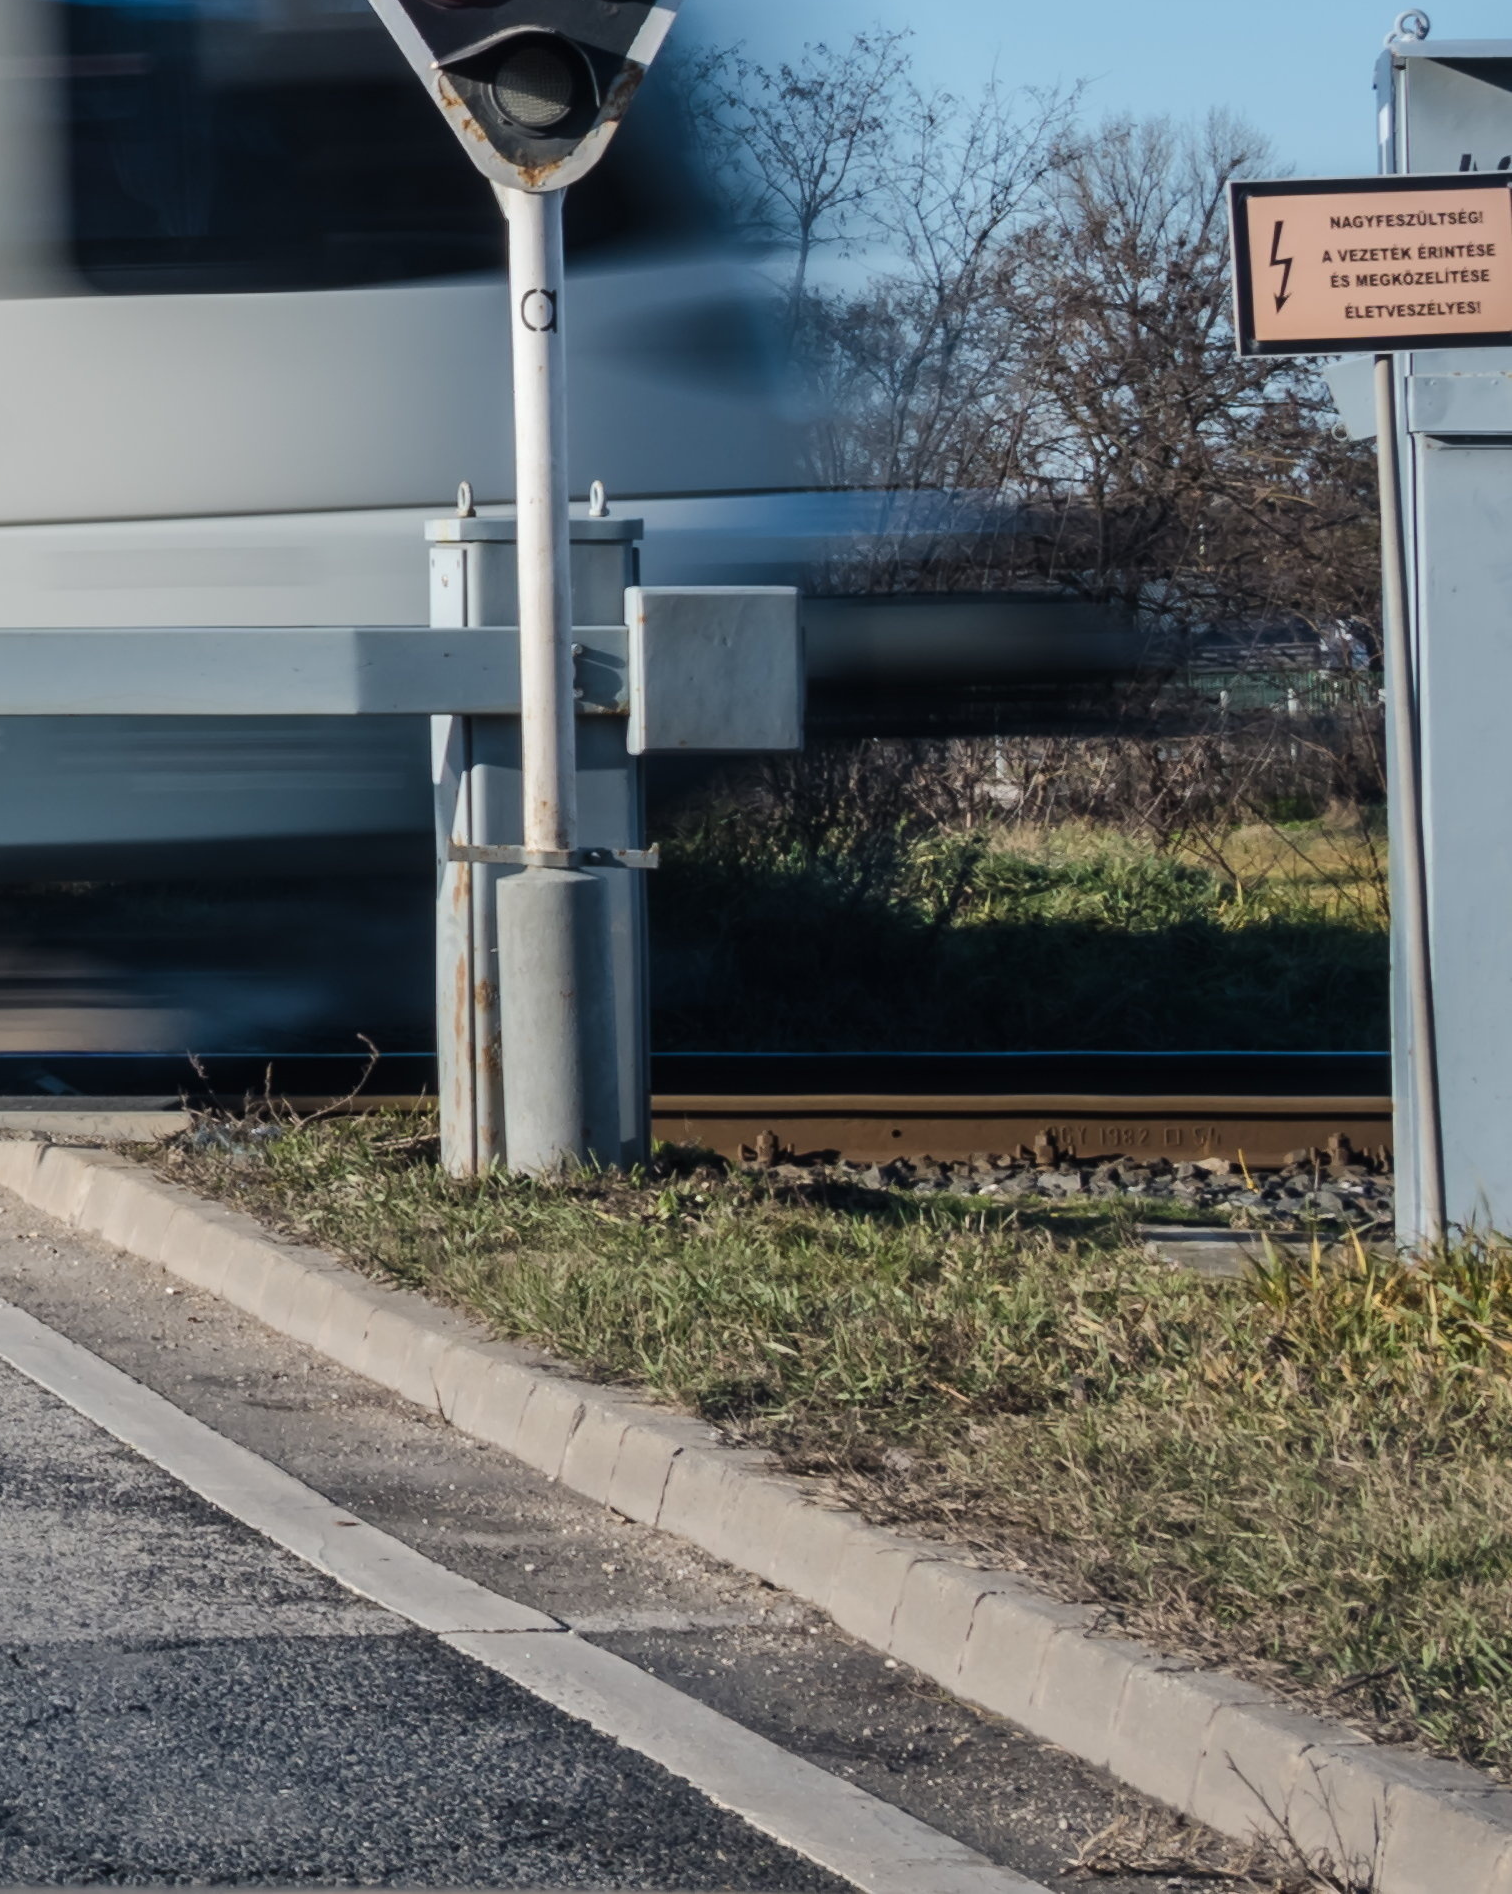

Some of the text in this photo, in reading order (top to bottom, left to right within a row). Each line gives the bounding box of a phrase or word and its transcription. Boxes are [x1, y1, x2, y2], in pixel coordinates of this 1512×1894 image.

[1330, 208, 1483, 229] NAGYFESZÜLTSÉG!
[1322, 242, 1496, 263] A VEZETÉK ÉRINTÉSE
[1330, 267, 1491, 288] ÉS MEGKÖZELÍTÉSE
[1345, 300, 1481, 319] ÉLETVESZÉLYES!
[1099, 1126, 1149, 1146] 1982
